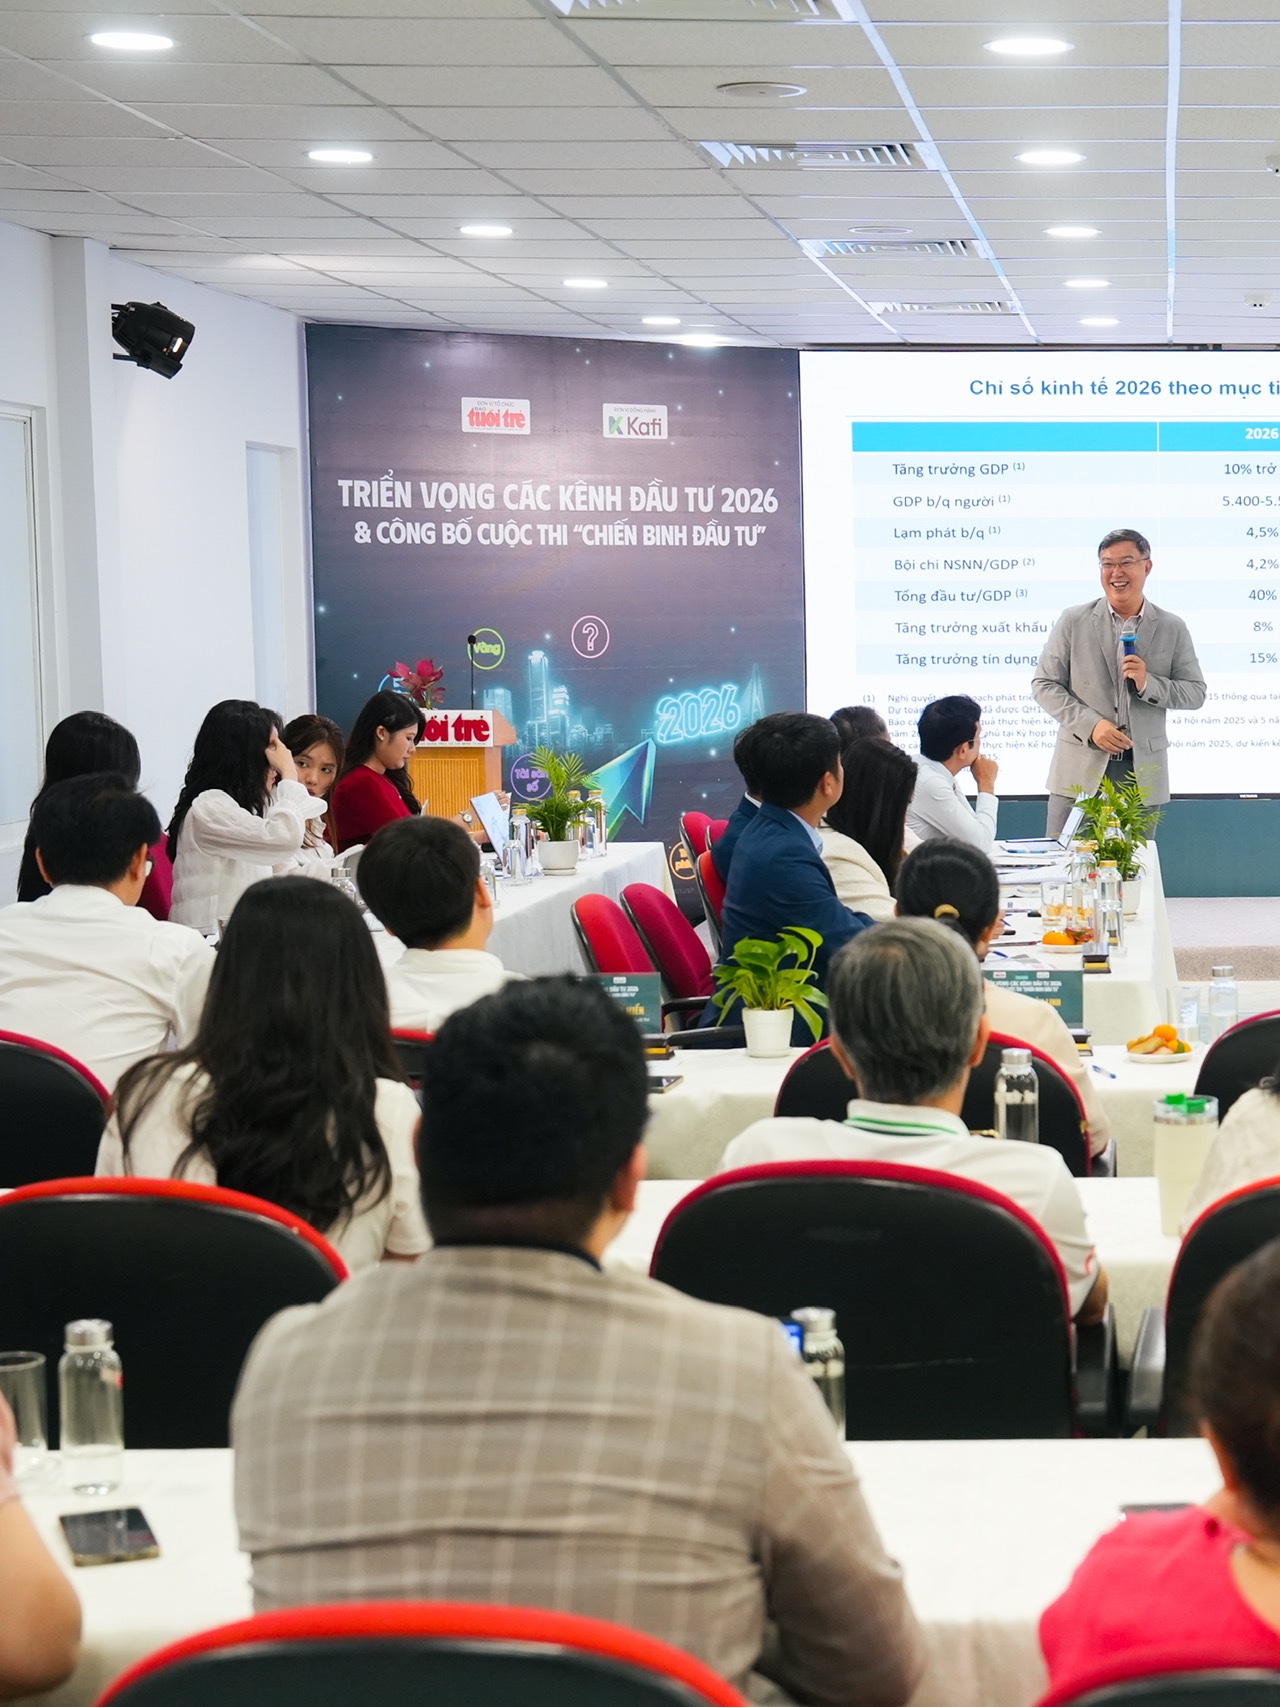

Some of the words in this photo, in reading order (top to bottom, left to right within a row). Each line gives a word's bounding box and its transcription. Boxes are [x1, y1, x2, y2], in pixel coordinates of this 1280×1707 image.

[1009, 376, 1034, 396] số
[1041, 380, 1084, 396] kinh
[1089, 376, 1109, 396] tế
[1115, 380, 1162, 396] 2026
[1167, 380, 1213, 396] theo
[1219, 383, 1262, 400] mục
[627, 416, 662, 436] Kafi
[1244, 427, 1280, 440] 2026
[892, 463, 924, 478] Tăng
[927, 462, 976, 478] trưởng
[979, 463, 1009, 476] GDP
[1012, 462, 1026, 472] (1)
[1224, 463, 1253, 475] 10%
[1255, 462, 1278, 475] trở
[338, 470, 409, 508] TRIỂN
[420, 482, 494, 513] VỌNG
[502, 480, 550, 511] CÁC
[559, 480, 621, 512] KÊNH
[629, 478, 677, 513] ĐẦU
[684, 485, 715, 513] TƯ
[721, 487, 778, 513] 2026
[892, 495, 923, 508] GDP
[926, 495, 951, 510] b/q
[954, 495, 995, 510] người
[998, 494, 1011, 504] (1)
[354, 522, 371, 544] &
[376, 518, 435, 545] CÔNG
[442, 517, 474, 545] BỐ
[477, 519, 532, 548] CUỘC
[537, 523, 567, 545] THI
[573, 518, 637, 546] “CHIẾN
[643, 525, 687, 546] BINH
[692, 519, 730, 546] ĐẦU
[735, 524, 766, 547] TƯ”
[893, 527, 922, 540] Lạm
[926, 527, 957, 541] phát
[960, 526, 985, 541] b/q
[988, 525, 1001, 535] (1)
[1245, 526, 1280, 540] 4,5%
[894, 558, 916, 572] Bội
[919, 559, 939, 571] chi
[943, 558, 1019, 572] NSNN/GDP
[1022, 557, 1036, 567] (2)
[1245, 558, 1280, 572] 4,2%
[893, 588, 927, 605] Tổng
[930, 588, 956, 602] đầu
[960, 589, 1012, 604] tư/GDP
[1015, 588, 1028, 599] (3)
[1248, 589, 1278, 601] 40%
[894, 621, 927, 637] Tăng
[930, 620, 978, 636] trưởng
[981, 620, 1011, 633] xuất
[1015, 620, 1048, 633] khẩu
[1252, 620, 1274, 633] 8%
[582, 622, 599, 651] ?
[895, 653, 928, 668] Tăng
[930, 652, 979, 668] trưởng
[982, 653, 1000, 665] tín
[1004, 653, 1038, 667] dụng
[1249, 652, 1278, 664] 15%
[656, 683, 741, 743] 2026
